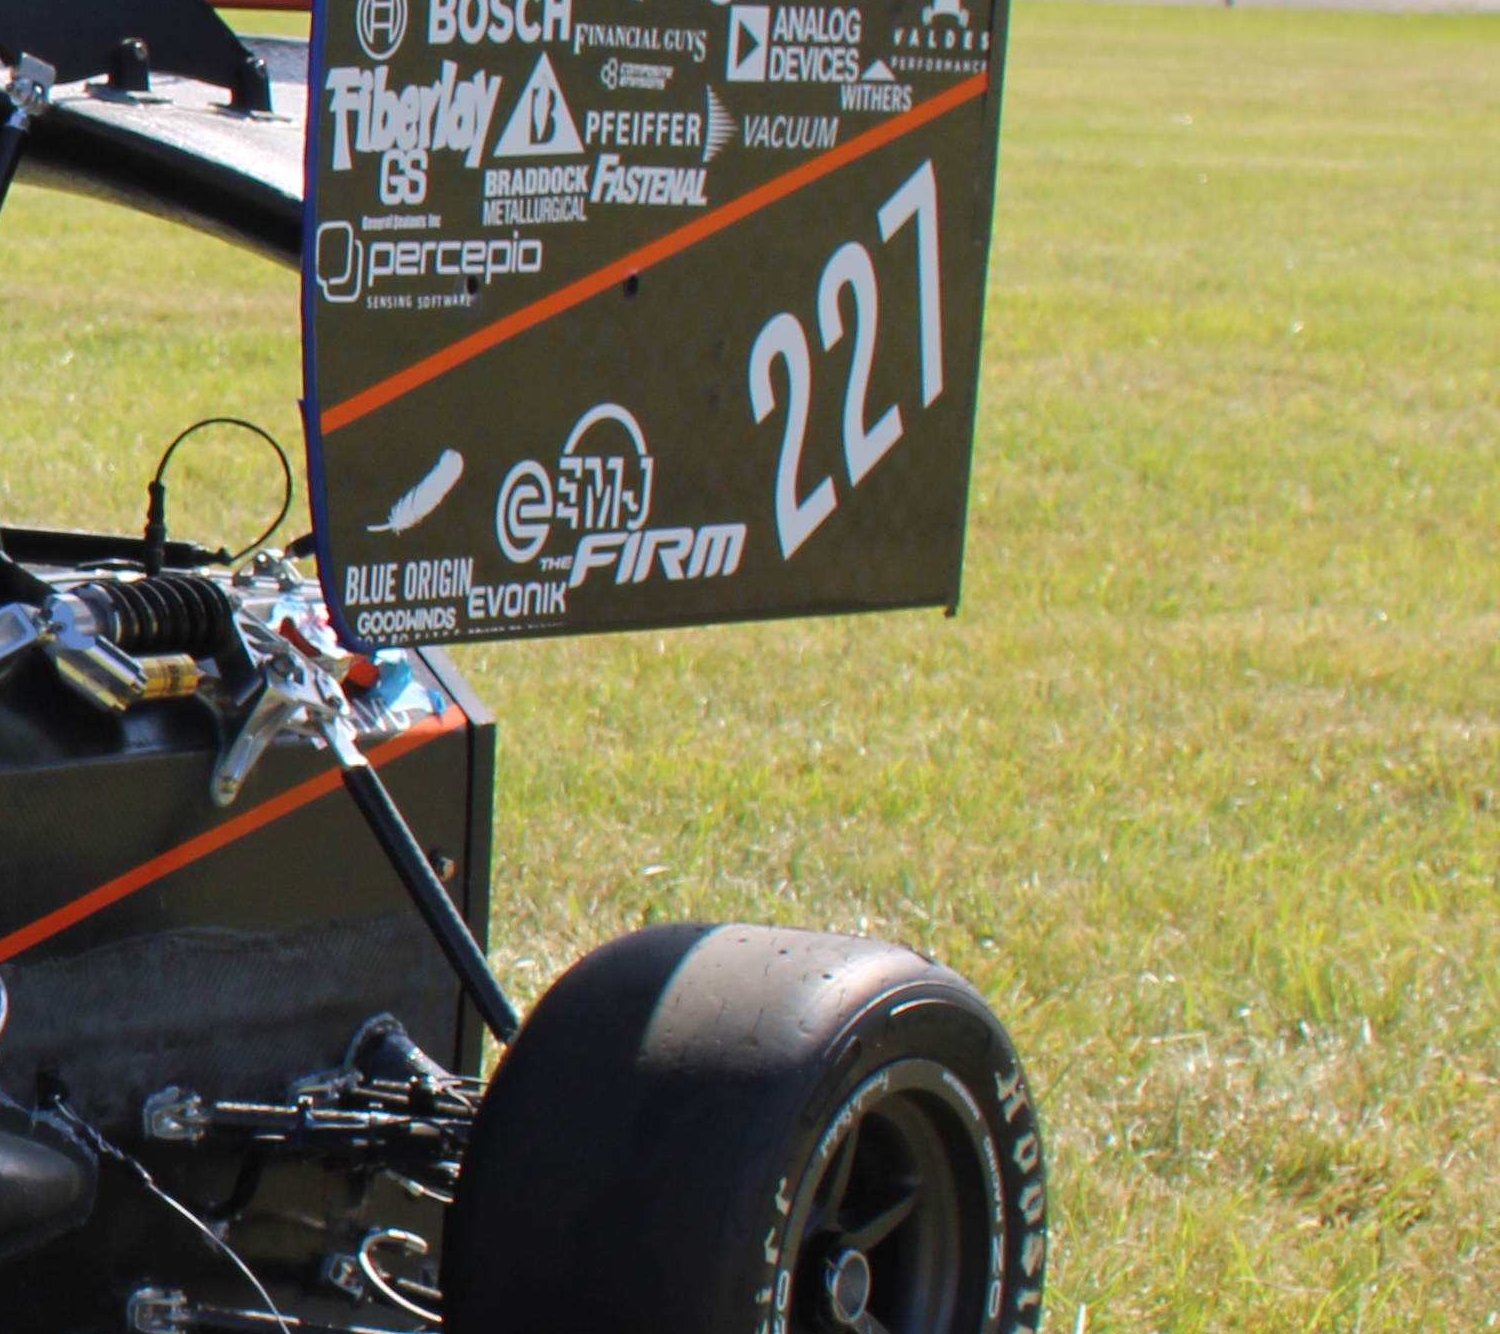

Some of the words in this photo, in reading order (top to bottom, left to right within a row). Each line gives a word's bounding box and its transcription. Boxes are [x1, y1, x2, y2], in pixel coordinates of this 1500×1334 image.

[573, 22, 661, 55] FINANCIAL
[664, 30, 708, 63] GUYS
[772, 6, 862, 43] ANALOG
[894, 28, 990, 51] VALDES
[769, 46, 860, 82] DEVICES
[890, 55, 987, 74] PERFORMANCE
[326, 60, 503, 170] Fiberlay
[840, 84, 913, 111] WITHERS
[585, 111, 701, 146] PFEIFFER
[743, 116, 839, 148] VACUUM
[380, 149, 428, 205] GS
[484, 165, 589, 197] BRADDOCK
[590, 153, 708, 206] FASTENAL
[482, 198, 587, 227] METALLURGICAL
[368, 231, 543, 287] percepio
[366, 295, 412, 309] SENSING
[417, 293, 473, 309] SOFTWARE
[749, 160, 945, 562] 227
[539, 555, 574, 571] THE
[568, 522, 748, 589] FIRM
[346, 564, 397, 606] BLUE
[404, 558, 474, 601] ORIGIN
[467, 582, 568, 620] EVONIK
[356, 607, 457, 636] GOODWINDS
